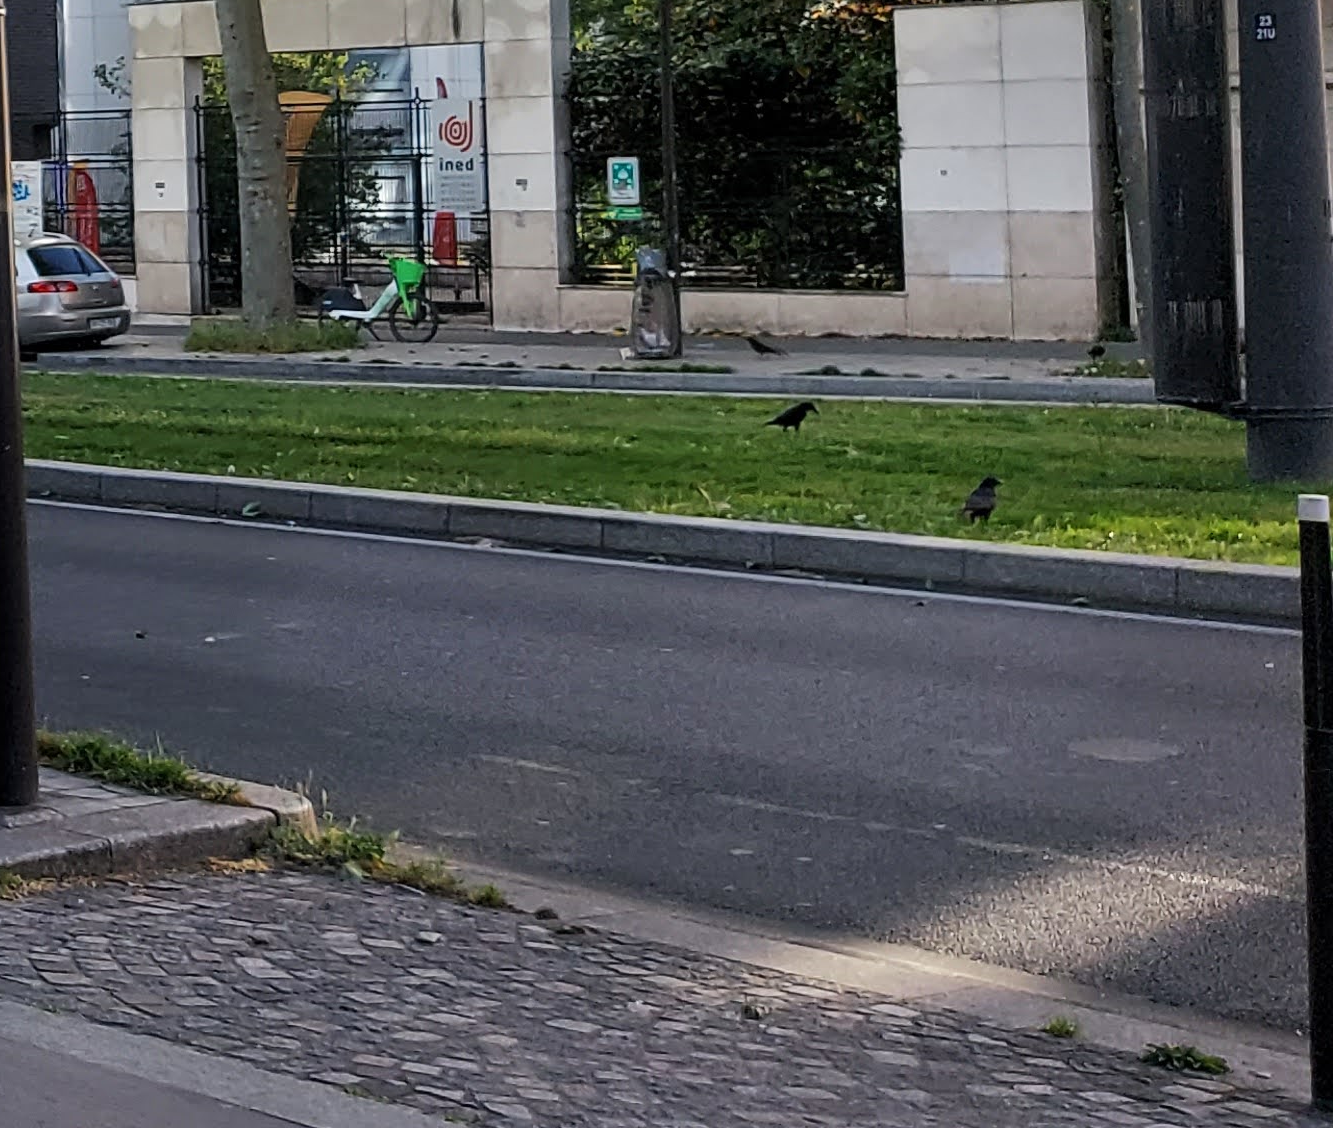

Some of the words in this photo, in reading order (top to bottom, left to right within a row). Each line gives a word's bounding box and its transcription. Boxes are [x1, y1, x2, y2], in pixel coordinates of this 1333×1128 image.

[1259, 15, 1273, 27] 23
[1256, 28, 1276, 40] 21U
[439, 157, 474, 172] ined
